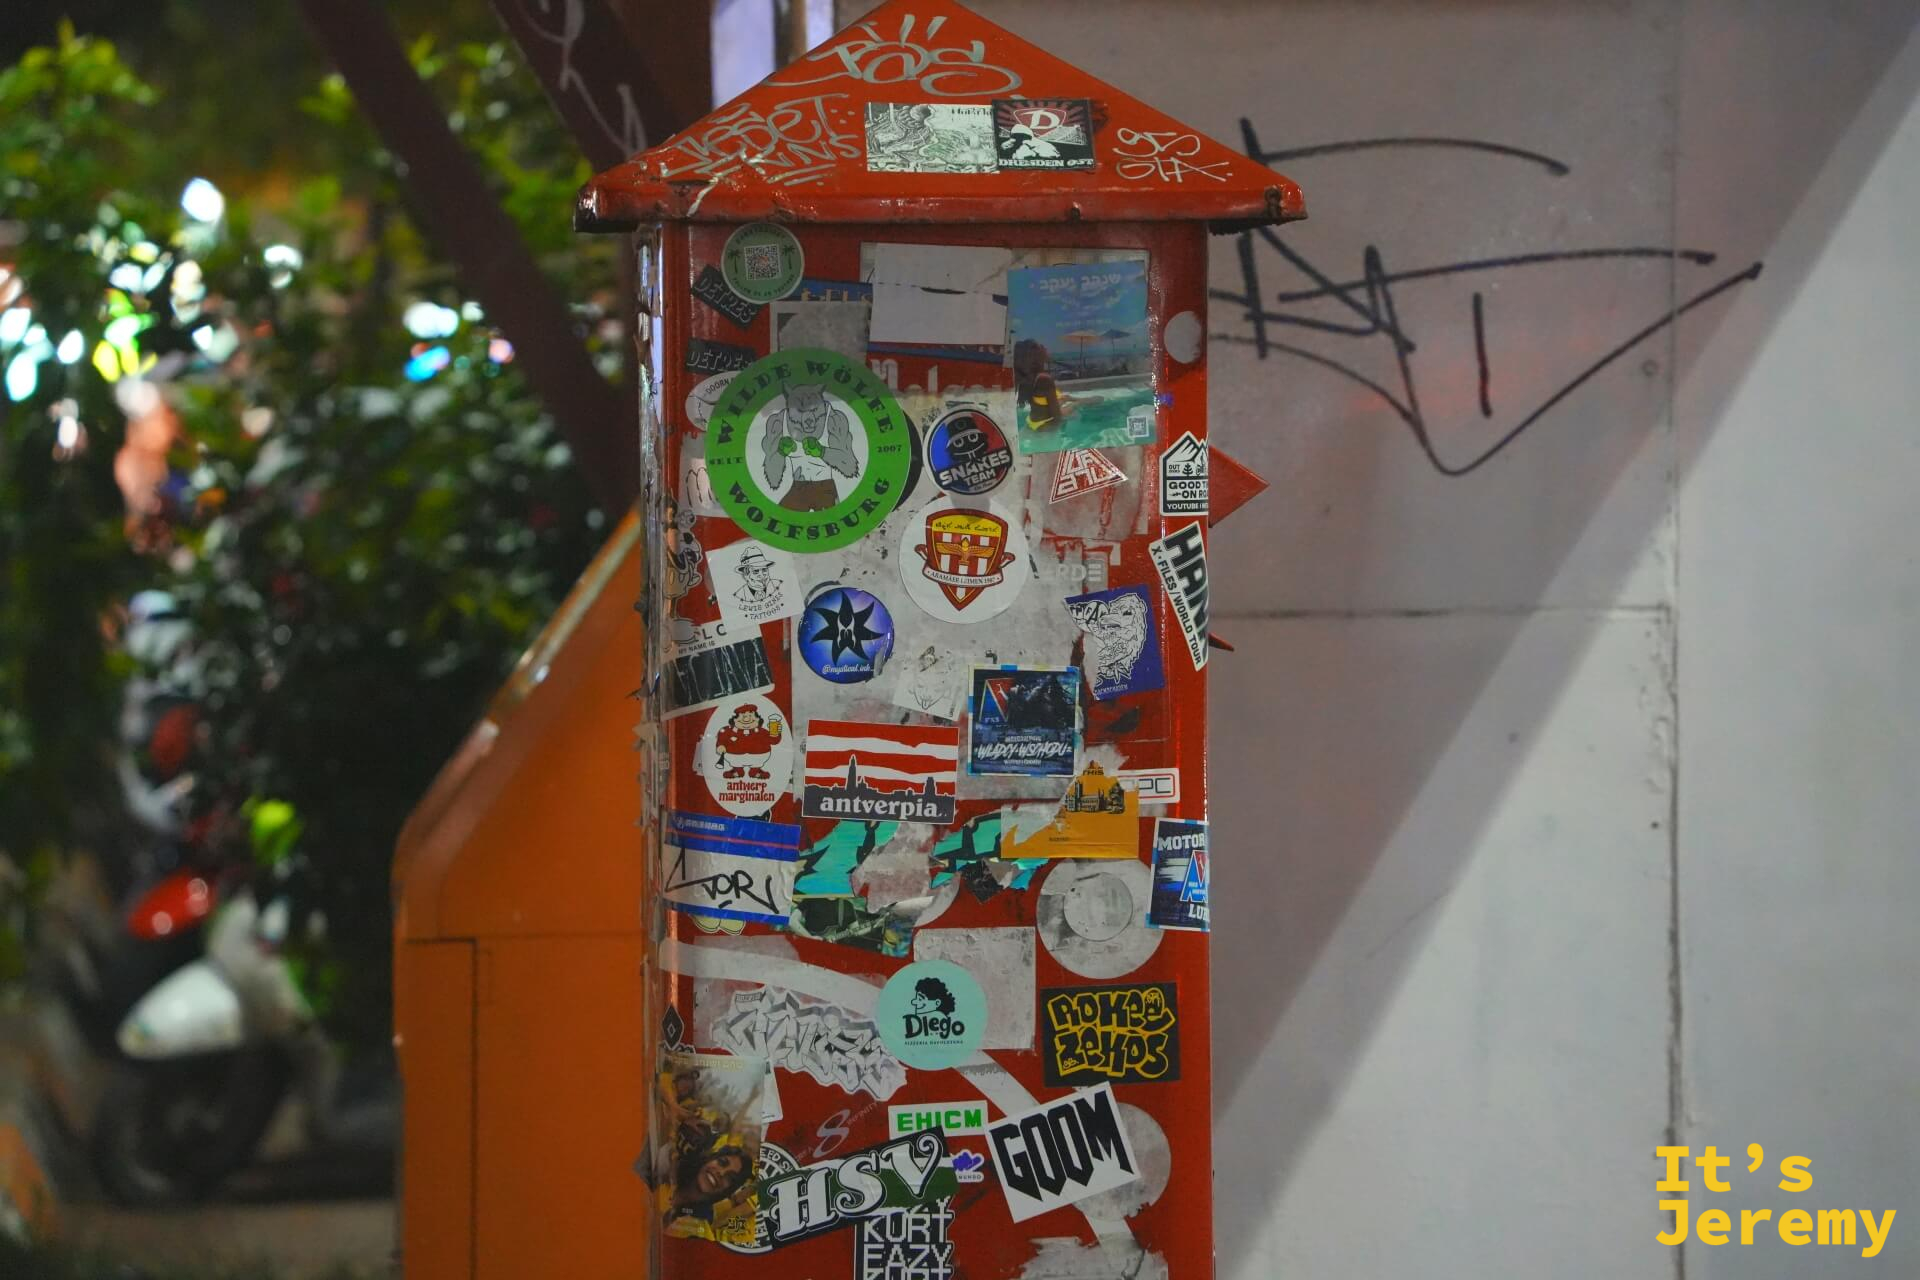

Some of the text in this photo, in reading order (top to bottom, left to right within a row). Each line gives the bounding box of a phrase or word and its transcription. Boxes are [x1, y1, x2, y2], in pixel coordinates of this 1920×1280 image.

[998, 158, 1065, 167] DRESDEN
[718, 363, 792, 445] WILDE
[939, 449, 1011, 486] SNAKES
[962, 467, 997, 486] TEAM
[1168, 481, 1201, 490] GOOD
[1181, 490, 1197, 499] ON
[728, 477, 891, 541] WOLFSBURG
[1167, 502, 1199, 510] YOUTUBE
[688, 643, 708, 652] NAME
[1189, 630, 1202, 666] TOUR
[726, 780, 768, 793] antwerp
[718, 791, 775, 804] marginalen
[1157, 832, 1206, 851] MOTOR
[767, 1133, 943, 1242] HSV
[863, 1212, 953, 1243] KURT
[863, 1243, 952, 1271] EAZY
